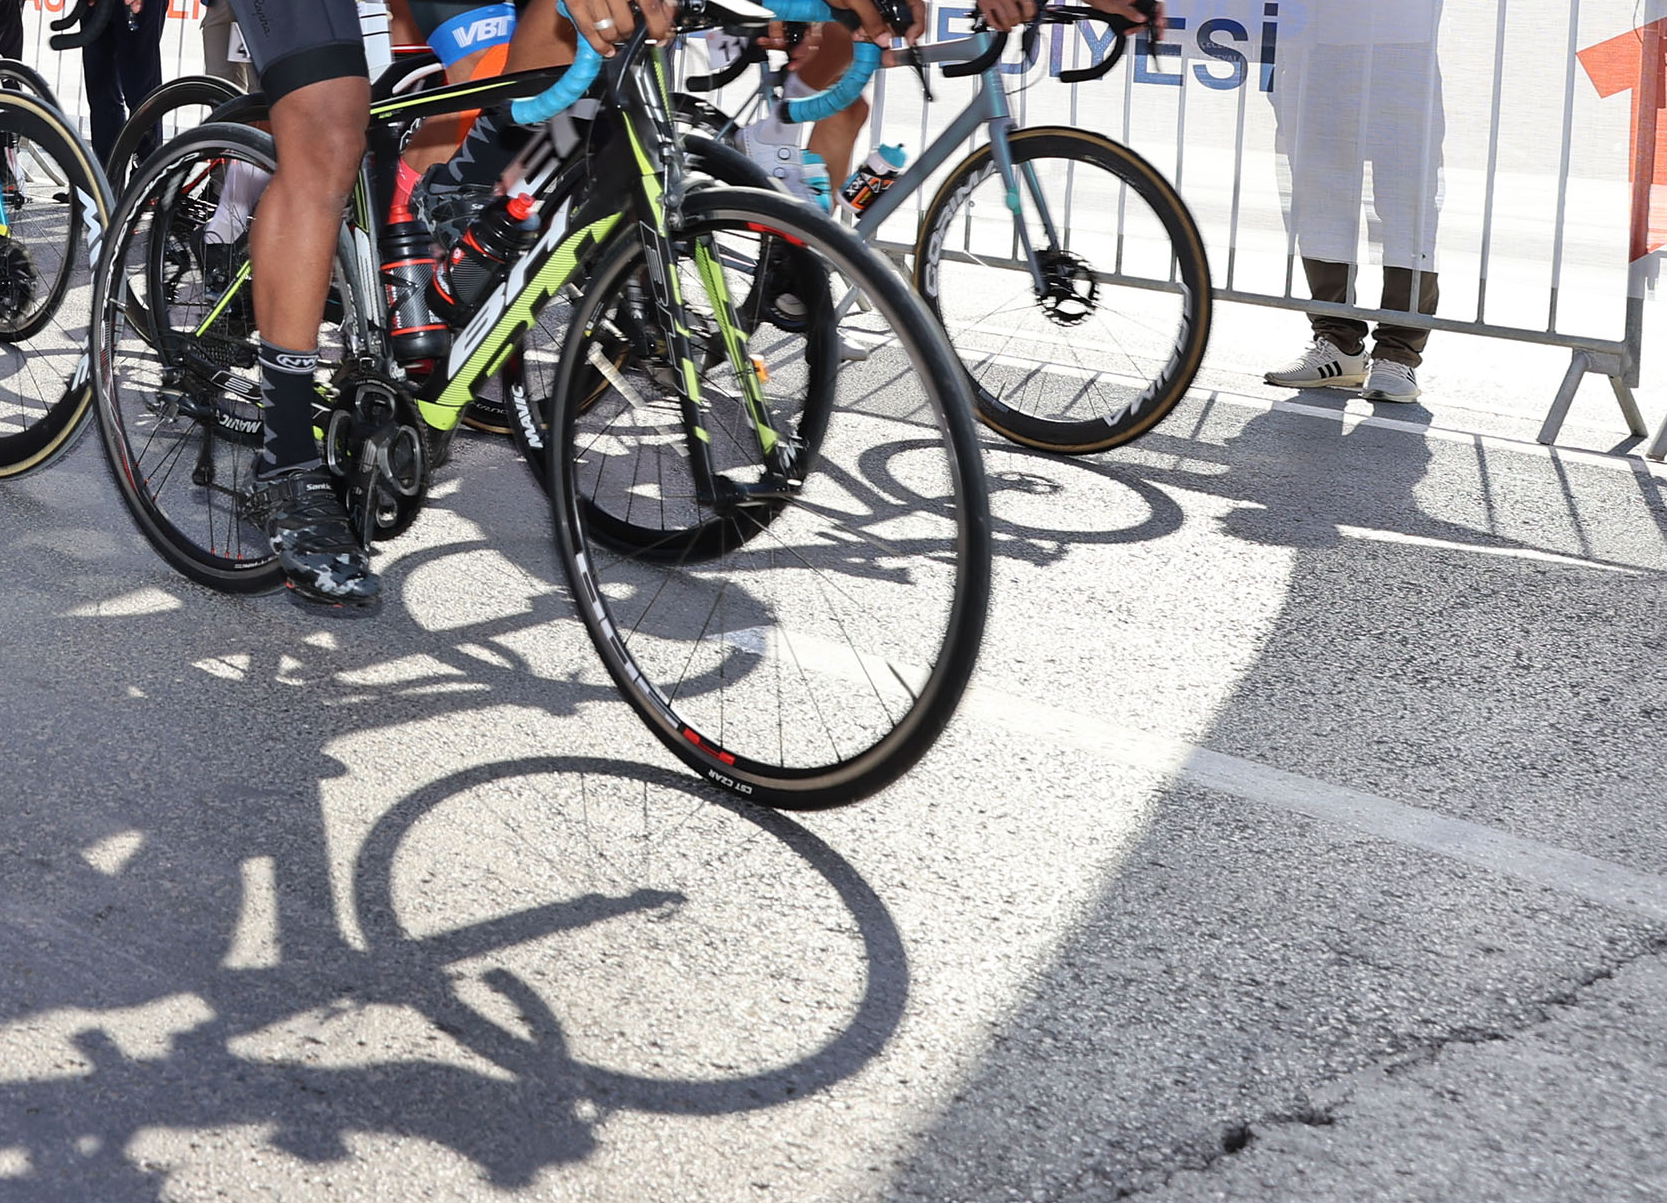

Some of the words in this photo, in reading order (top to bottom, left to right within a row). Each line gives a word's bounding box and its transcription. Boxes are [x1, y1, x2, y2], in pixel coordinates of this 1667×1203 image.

[218, 413, 262, 434] MAVIC
[511, 384, 543, 449] MAVIC
[708, 768, 734, 787] CZAR
